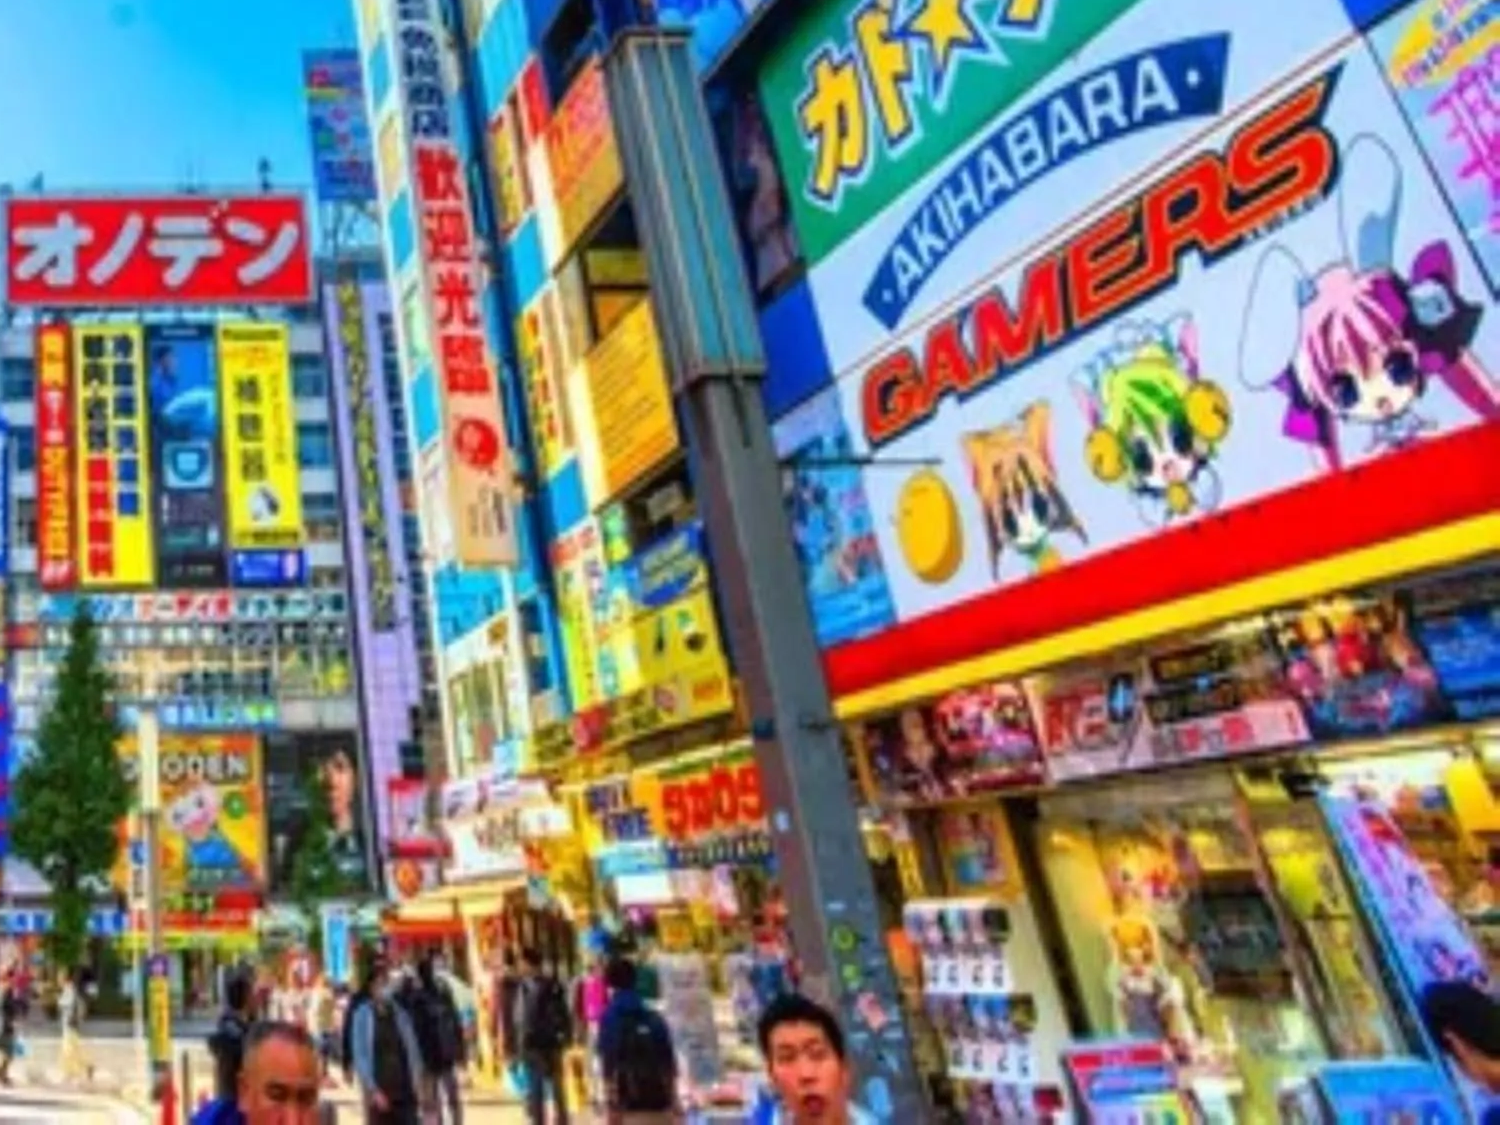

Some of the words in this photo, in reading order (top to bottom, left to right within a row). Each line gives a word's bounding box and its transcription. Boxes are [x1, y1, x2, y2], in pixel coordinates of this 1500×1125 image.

[12, 200, 299, 287] オノデン
[861, 62, 1346, 451] GAMERS
[890, 55, 1179, 293] AKIHABARA
